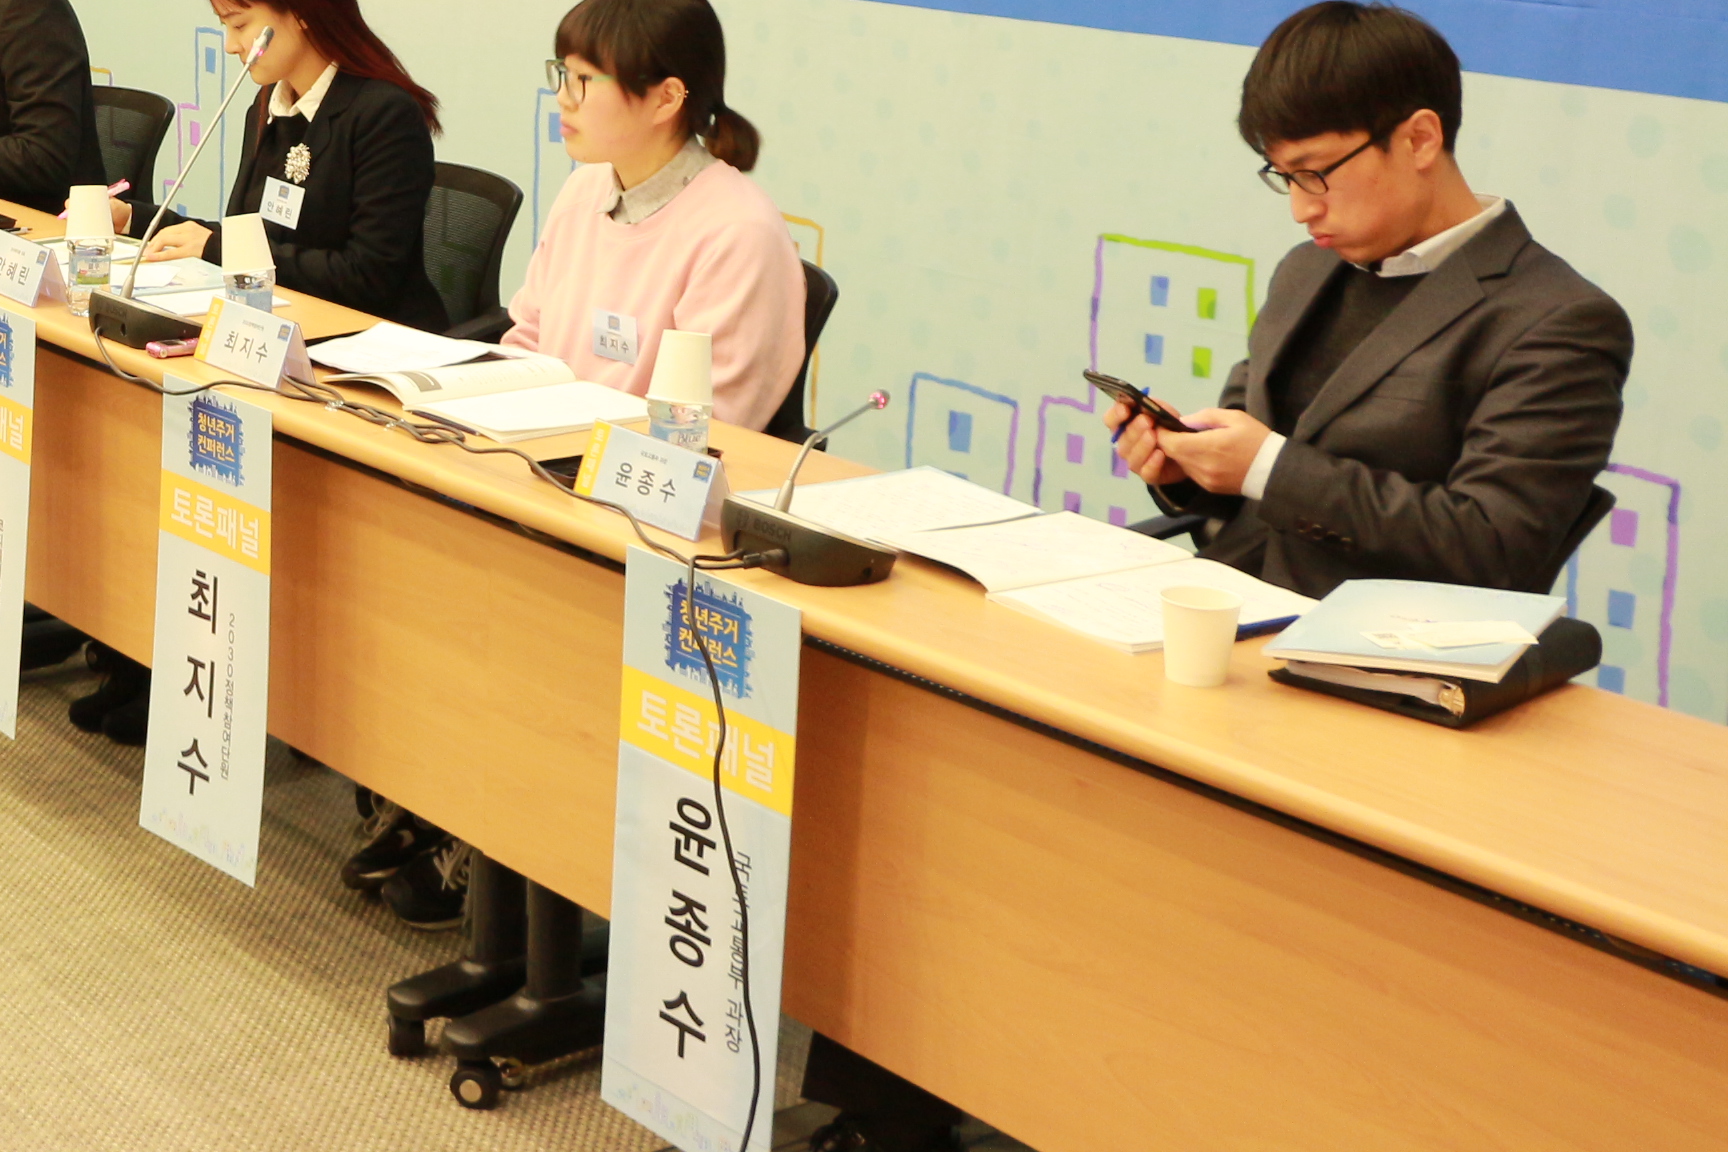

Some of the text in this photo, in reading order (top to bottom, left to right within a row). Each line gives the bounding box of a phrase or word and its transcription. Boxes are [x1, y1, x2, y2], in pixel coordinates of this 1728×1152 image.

[223, 330, 269, 364] 최지수
[197, 411, 237, 444] 청년주거
[197, 433, 236, 463] 컨퍼런스
[614, 461, 677, 504] 윤종수
[170, 487, 260, 559] 토론패널
[176, 569, 219, 796] 최지수
[637, 689, 775, 793] 토론패널
[659, 796, 717, 1060] 윤종수
[724, 998, 745, 1054] 과장
